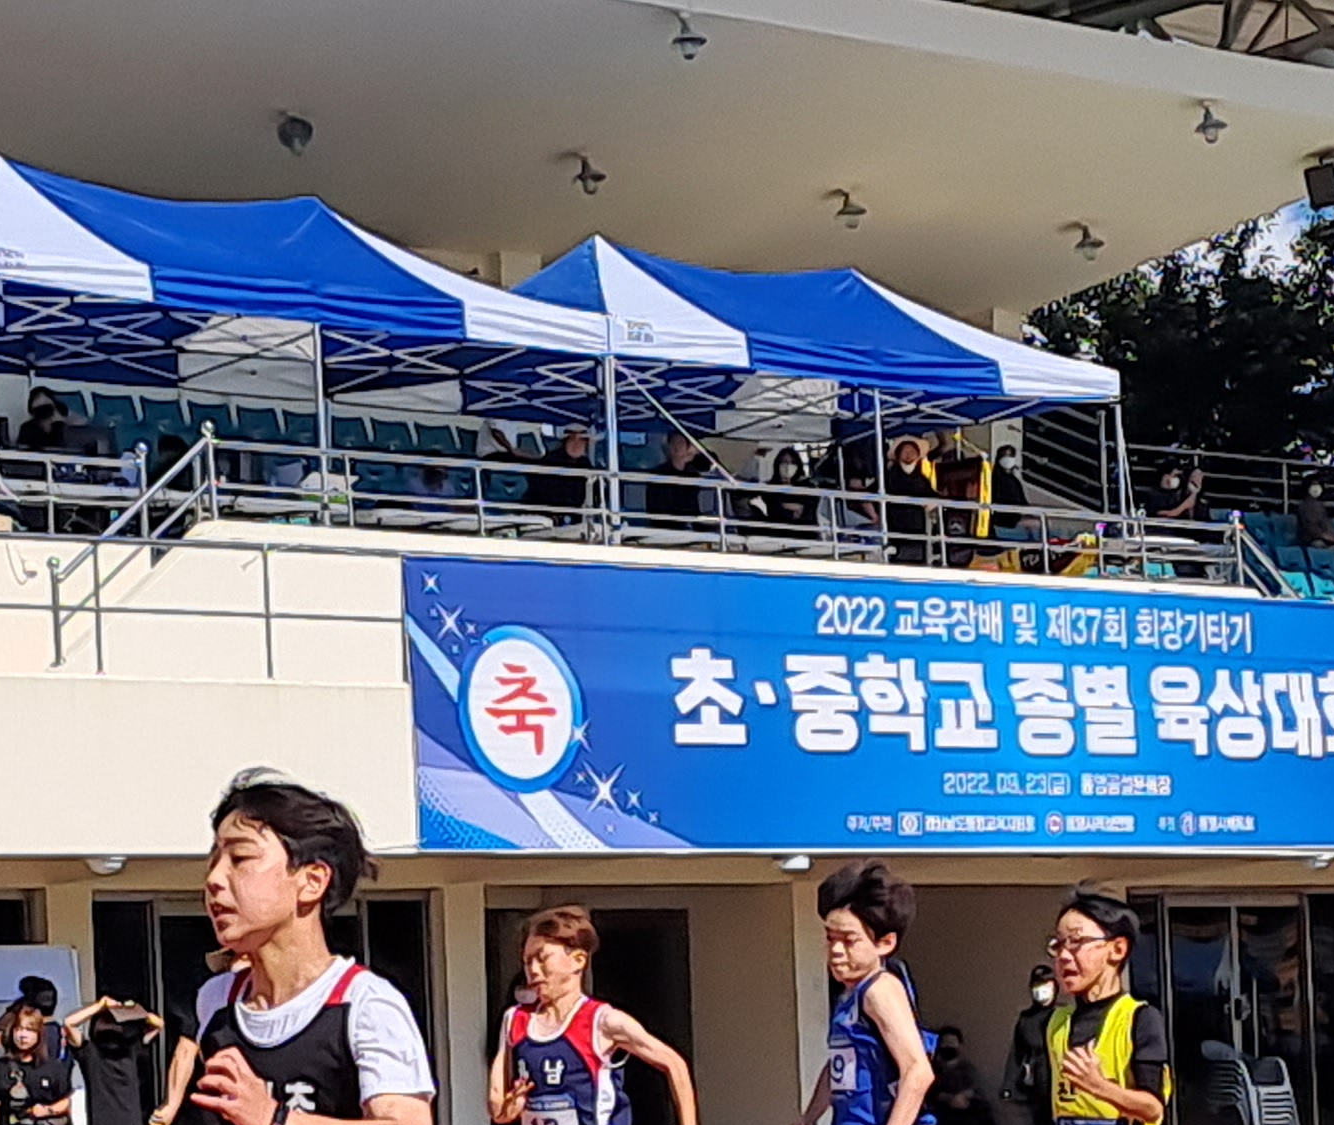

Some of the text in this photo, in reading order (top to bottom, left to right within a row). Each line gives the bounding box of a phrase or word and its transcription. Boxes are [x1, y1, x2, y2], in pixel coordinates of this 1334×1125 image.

[815, 594, 1253, 654] 2022 교육장배 및 제37회 회장기타기
[484, 661, 557, 756] 축
[669, 647, 1000, 754] 초·중학교
[1007, 661, 1140, 757] 종별
